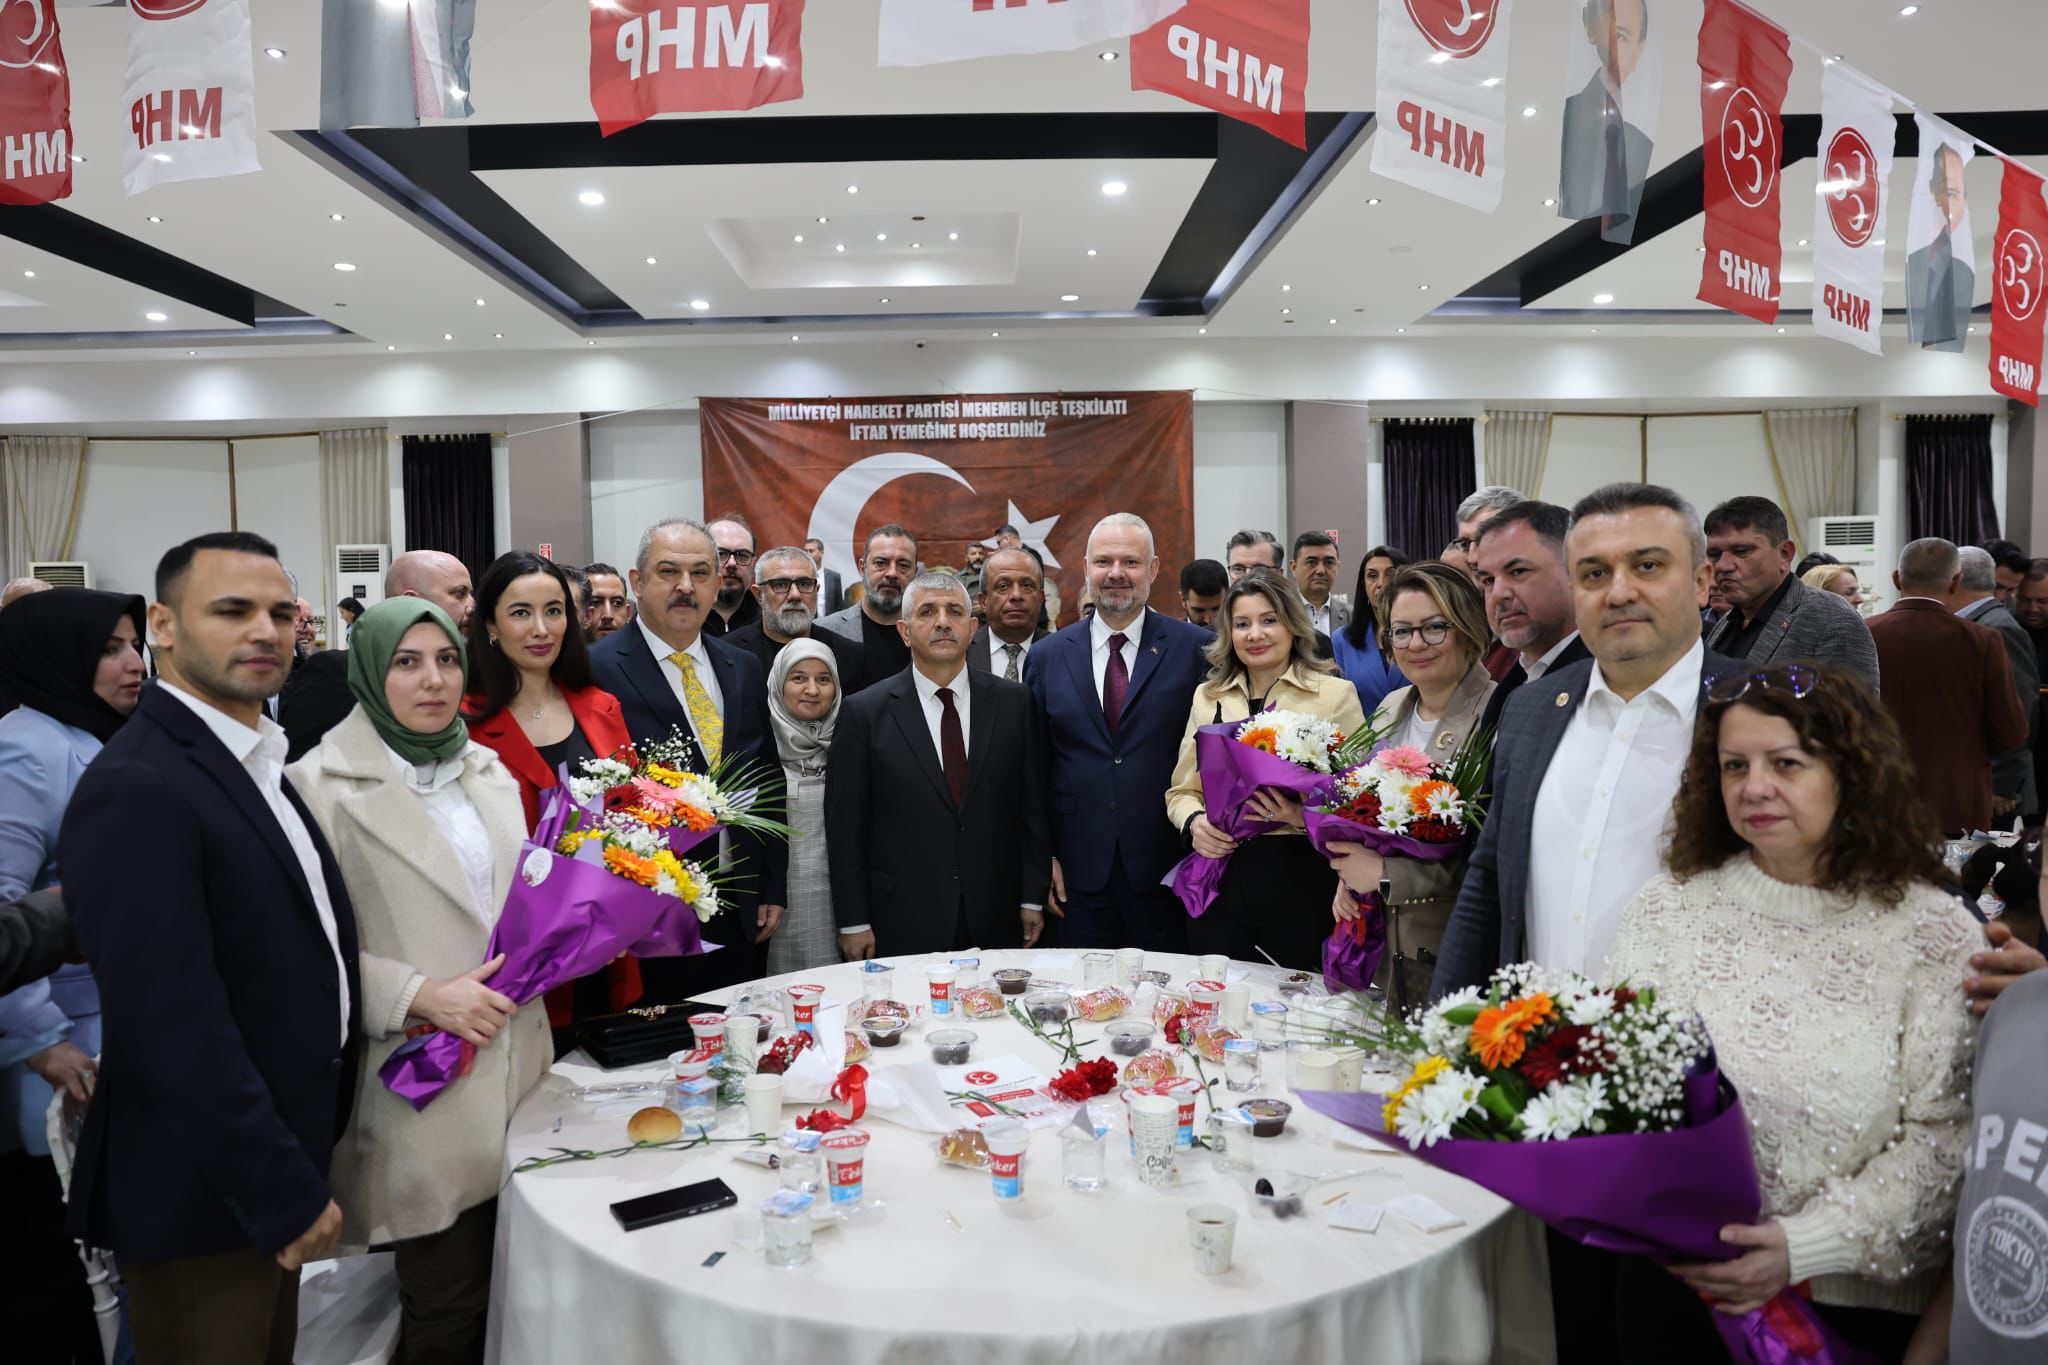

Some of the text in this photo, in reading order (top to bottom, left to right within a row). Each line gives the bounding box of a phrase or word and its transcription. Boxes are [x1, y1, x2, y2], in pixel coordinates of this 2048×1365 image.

[768, 397, 1127, 423] MİLLİYETÇİ HAREKET PARTİSİ MENEMEN İLÇE TEŞKİLATI
[850, 419, 1046, 441] İFTAR YEMEĞİNE HOŞGELDİNİZ
[1964, 1113, 2048, 1196] PE
[1989, 1224, 2034, 1269] TOKYO
